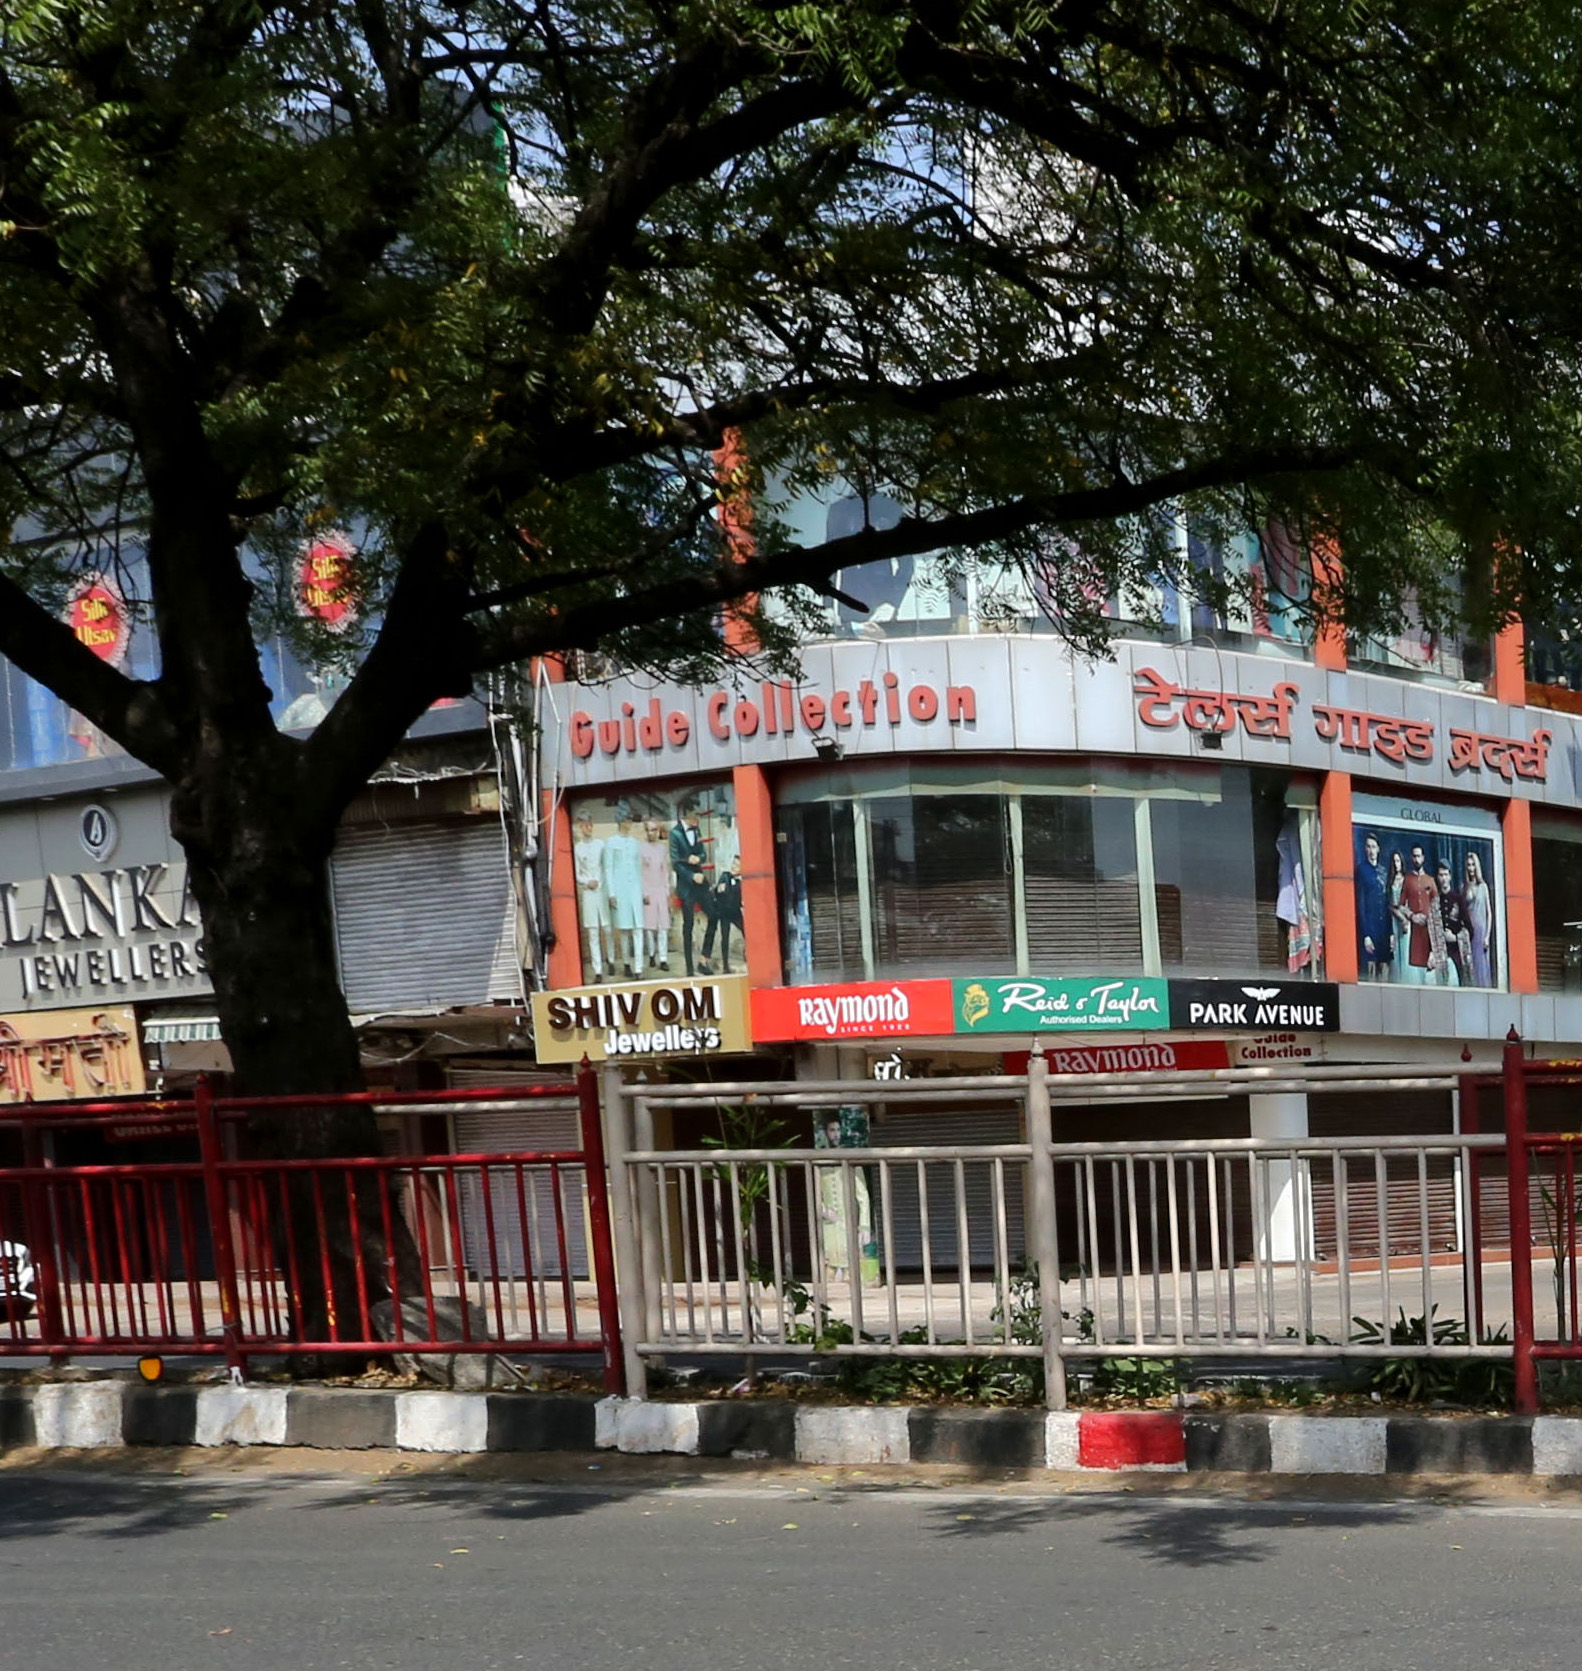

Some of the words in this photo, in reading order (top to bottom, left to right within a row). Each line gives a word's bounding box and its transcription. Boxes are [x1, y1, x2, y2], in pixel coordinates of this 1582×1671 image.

[569, 698, 690, 758] Guide
[707, 672, 976, 740] Collection
[1134, 667, 1299, 739] टेलर्स
[1313, 705, 1434, 763] गाइड
[1448, 728, 1553, 781] ब्रदर्स
[1400, 807, 1442, 824] GLOBAL
[548, 992, 642, 1030] SHIV
[651, 986, 721, 1022] OM
[798, 987, 909, 1034] Raymond
[998, 983, 1069, 1013] Reid
[1090, 982, 1159, 1021] Taylor
[1189, 1003, 1247, 1024] PARK
[1254, 1004, 1324, 1026] AVENUE
[1040, 1015, 1088, 1025] Authorised
[1089, 1015, 1123, 1024] Dealers
[1053, 1043, 1176, 1073] Raymond
[1241, 1046, 1311, 1060] Collection
